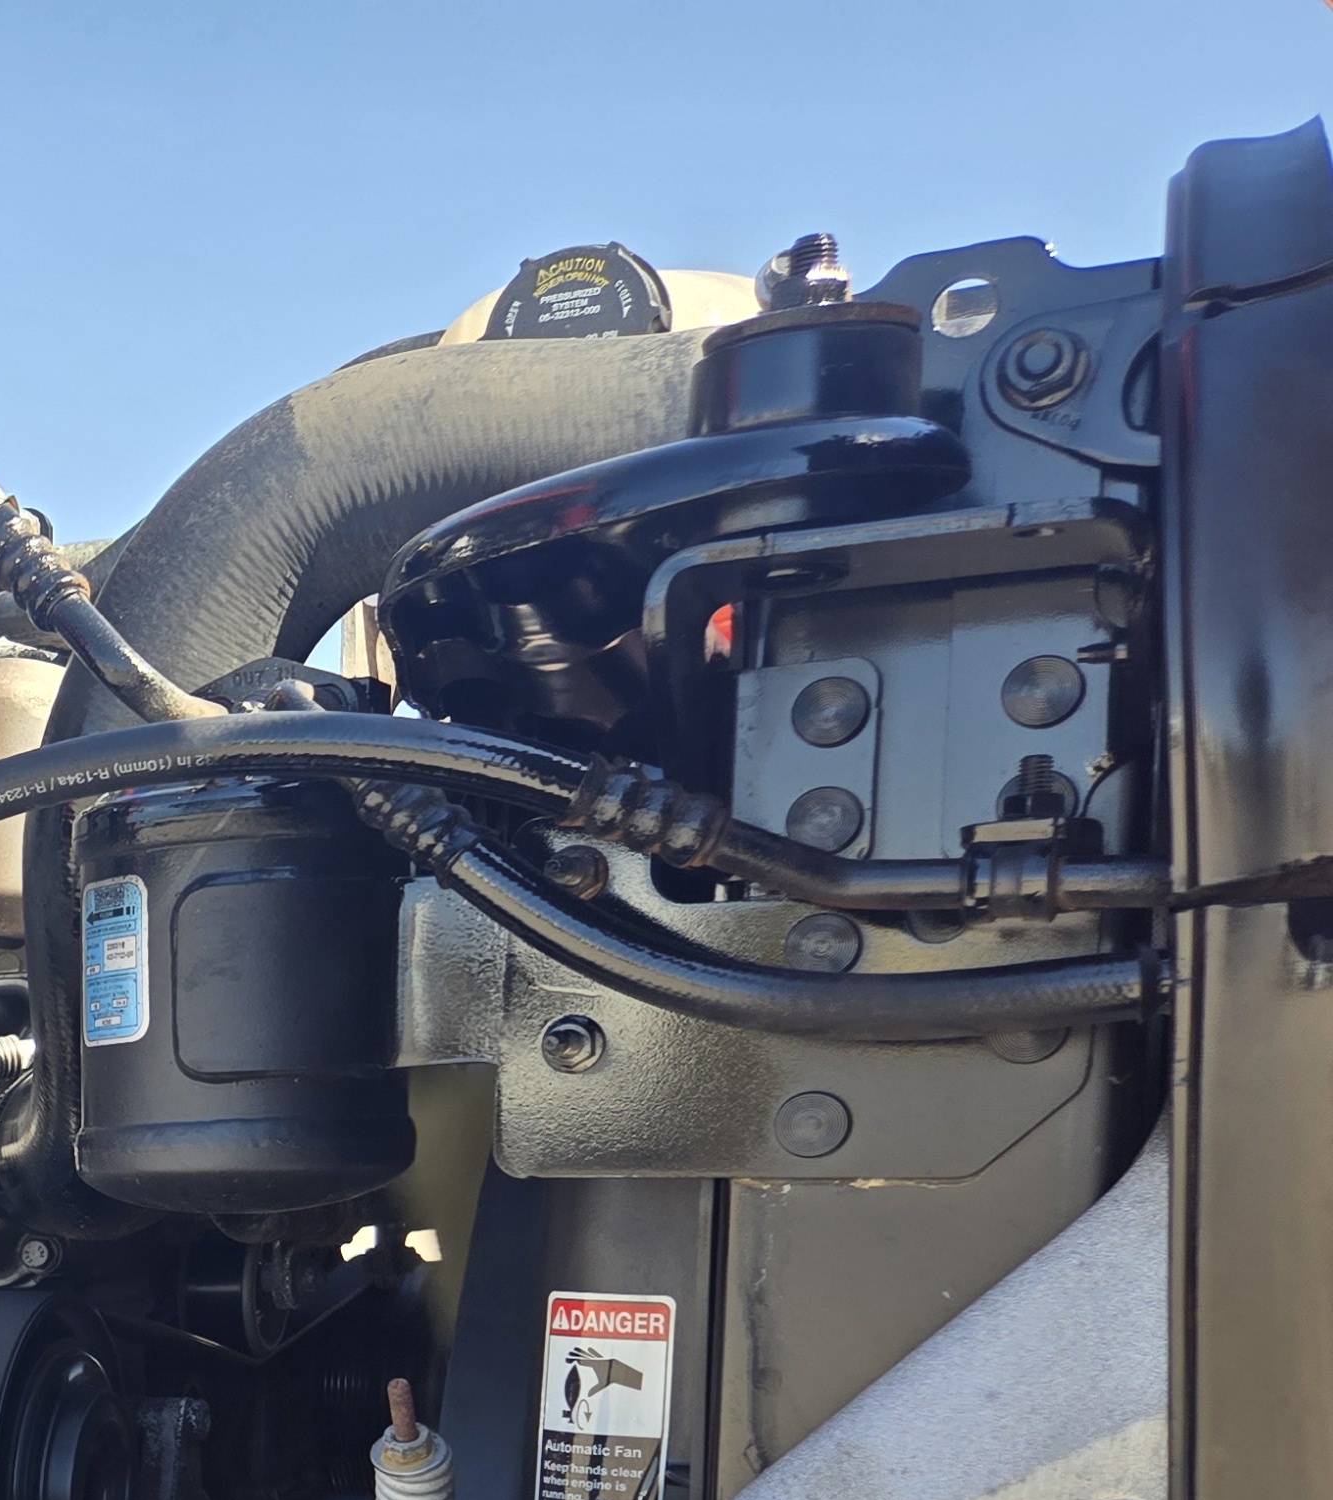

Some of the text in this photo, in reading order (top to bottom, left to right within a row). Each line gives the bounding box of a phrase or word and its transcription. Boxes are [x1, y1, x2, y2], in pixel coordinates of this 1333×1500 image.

[549, 257, 606, 276] CAUTION
[591, 272, 610, 288] HOT
[540, 287, 602, 305] PRESSURIZED
[551, 298, 589, 312] SYSTEM
[113, 754, 172, 778] (10mm)
[176, 754, 192, 768] in
[57, 766, 110, 787] R-134a
[570, 1310, 665, 1335] DANGER
[545, 1439, 642, 1458] Automatic Fan
[544, 1460, 644, 1479] Keep hands clear
[543, 1475, 627, 1492] when engine is
